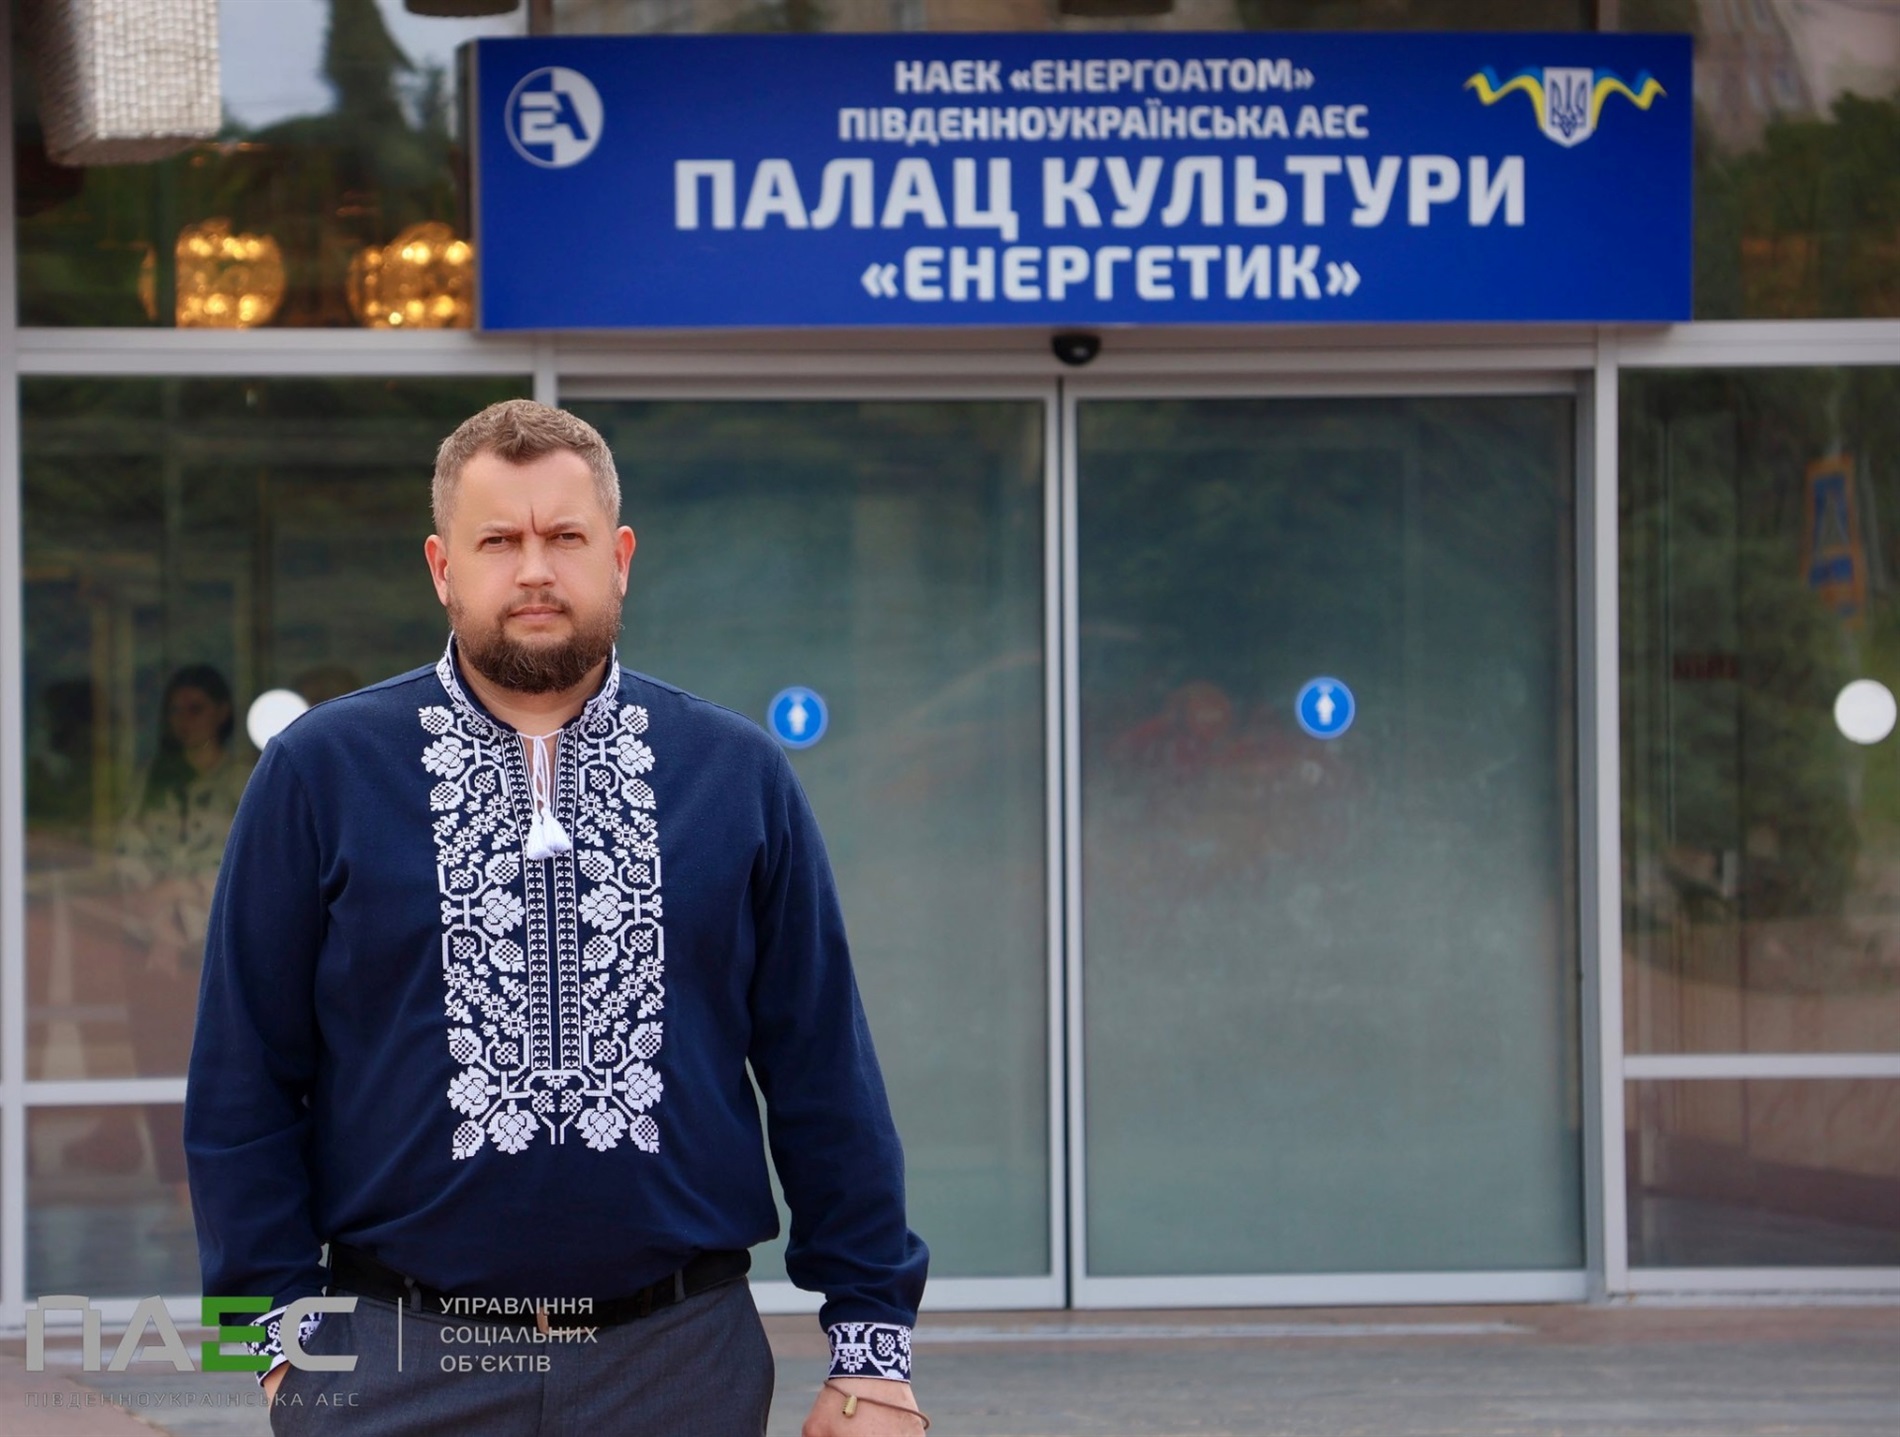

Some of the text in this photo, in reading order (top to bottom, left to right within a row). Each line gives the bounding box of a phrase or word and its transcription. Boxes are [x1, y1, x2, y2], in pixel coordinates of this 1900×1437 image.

[893, 60, 1002, 93] НАЕК
[838, 98, 1370, 145] ПІВДЕННОУКРАЇНСЬКА АЕС
[674, 154, 1526, 241] ПАЛАЦ КУЛЬТУРИ
